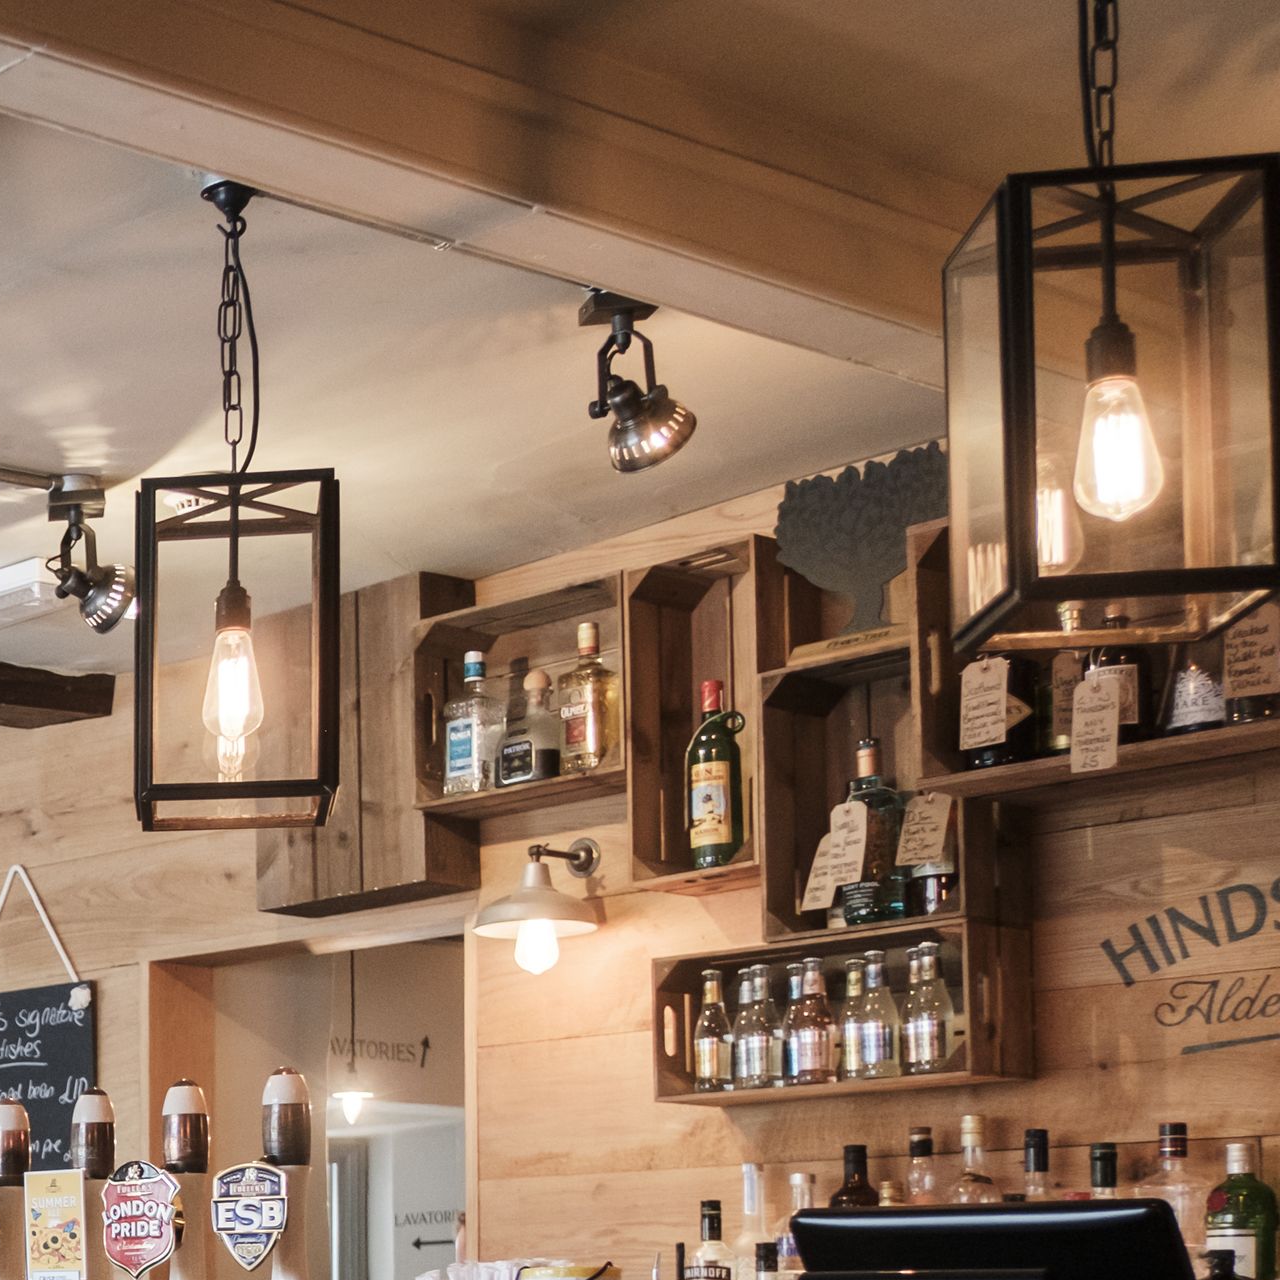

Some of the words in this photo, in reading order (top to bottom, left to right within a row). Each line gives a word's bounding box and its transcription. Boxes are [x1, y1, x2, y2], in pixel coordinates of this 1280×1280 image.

[27, 1079, 55, 1100] bean
[31, 1196, 78, 1209] SUMMER
[102, 1200, 175, 1226] LONDON
[216, 1199, 284, 1232] ESB
[111, 1219, 163, 1238] PRIDE
